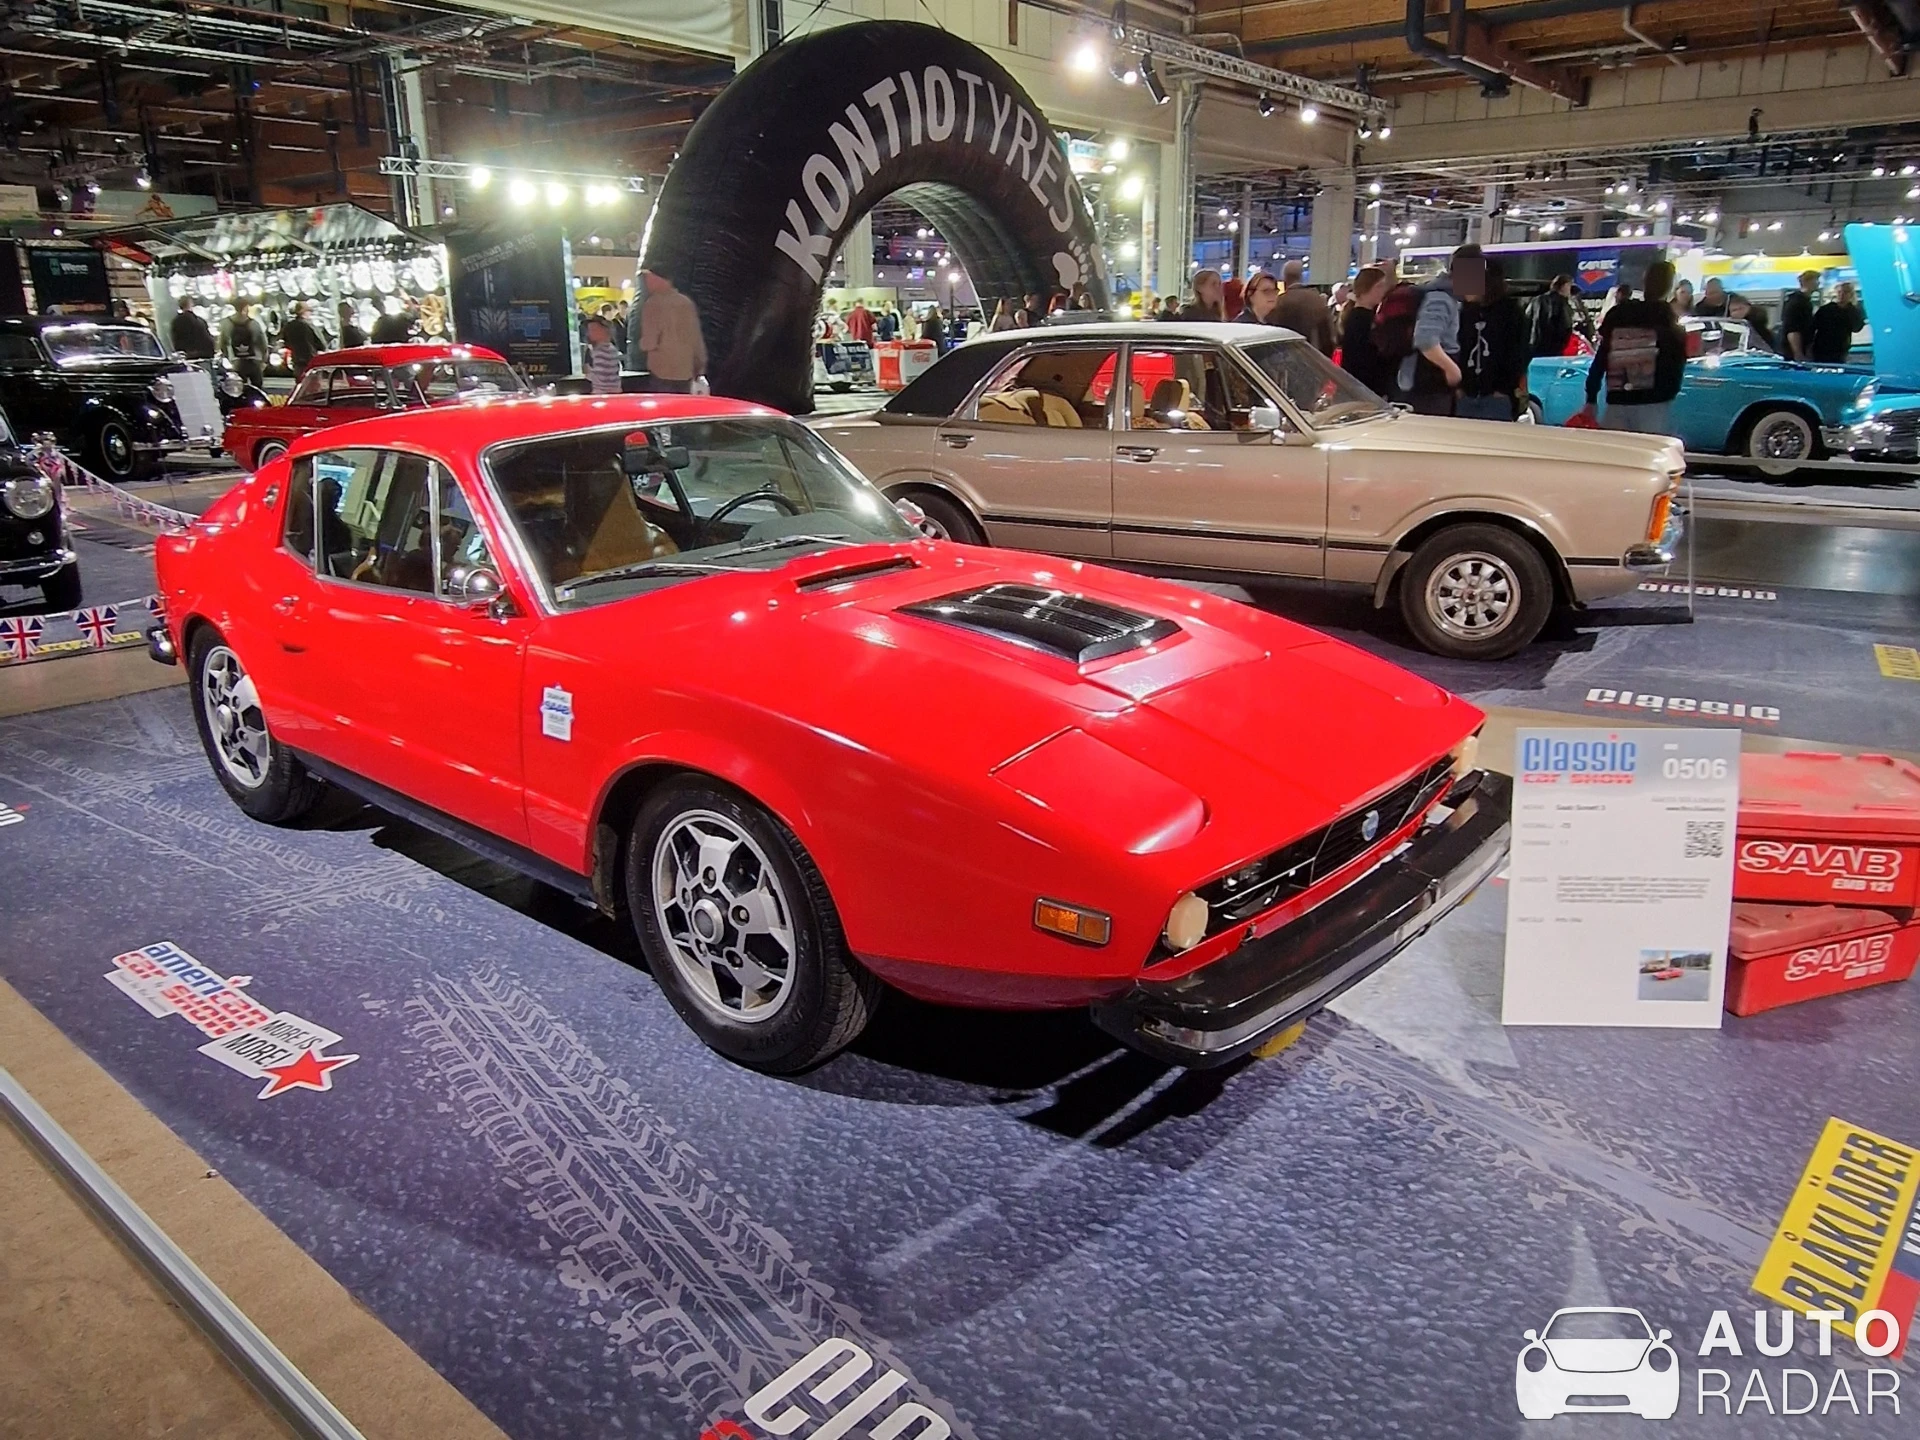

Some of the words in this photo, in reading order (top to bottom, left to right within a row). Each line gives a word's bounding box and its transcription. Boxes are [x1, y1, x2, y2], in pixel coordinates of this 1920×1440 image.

[1524, 734, 1636, 772] Classic
[1662, 758, 1728, 779] 0506
[1738, 841, 1902, 881] SAAB
[118, 952, 168, 980] car
[1784, 933, 1894, 981] SAAB
[143, 943, 269, 1030] american
[222, 1033, 294, 1068] MORE!
[259, 1019, 303, 1044] MORE
[293, 1032, 325, 1050] IS
[1781, 1132, 1914, 1324] BLÅKLÄDER
